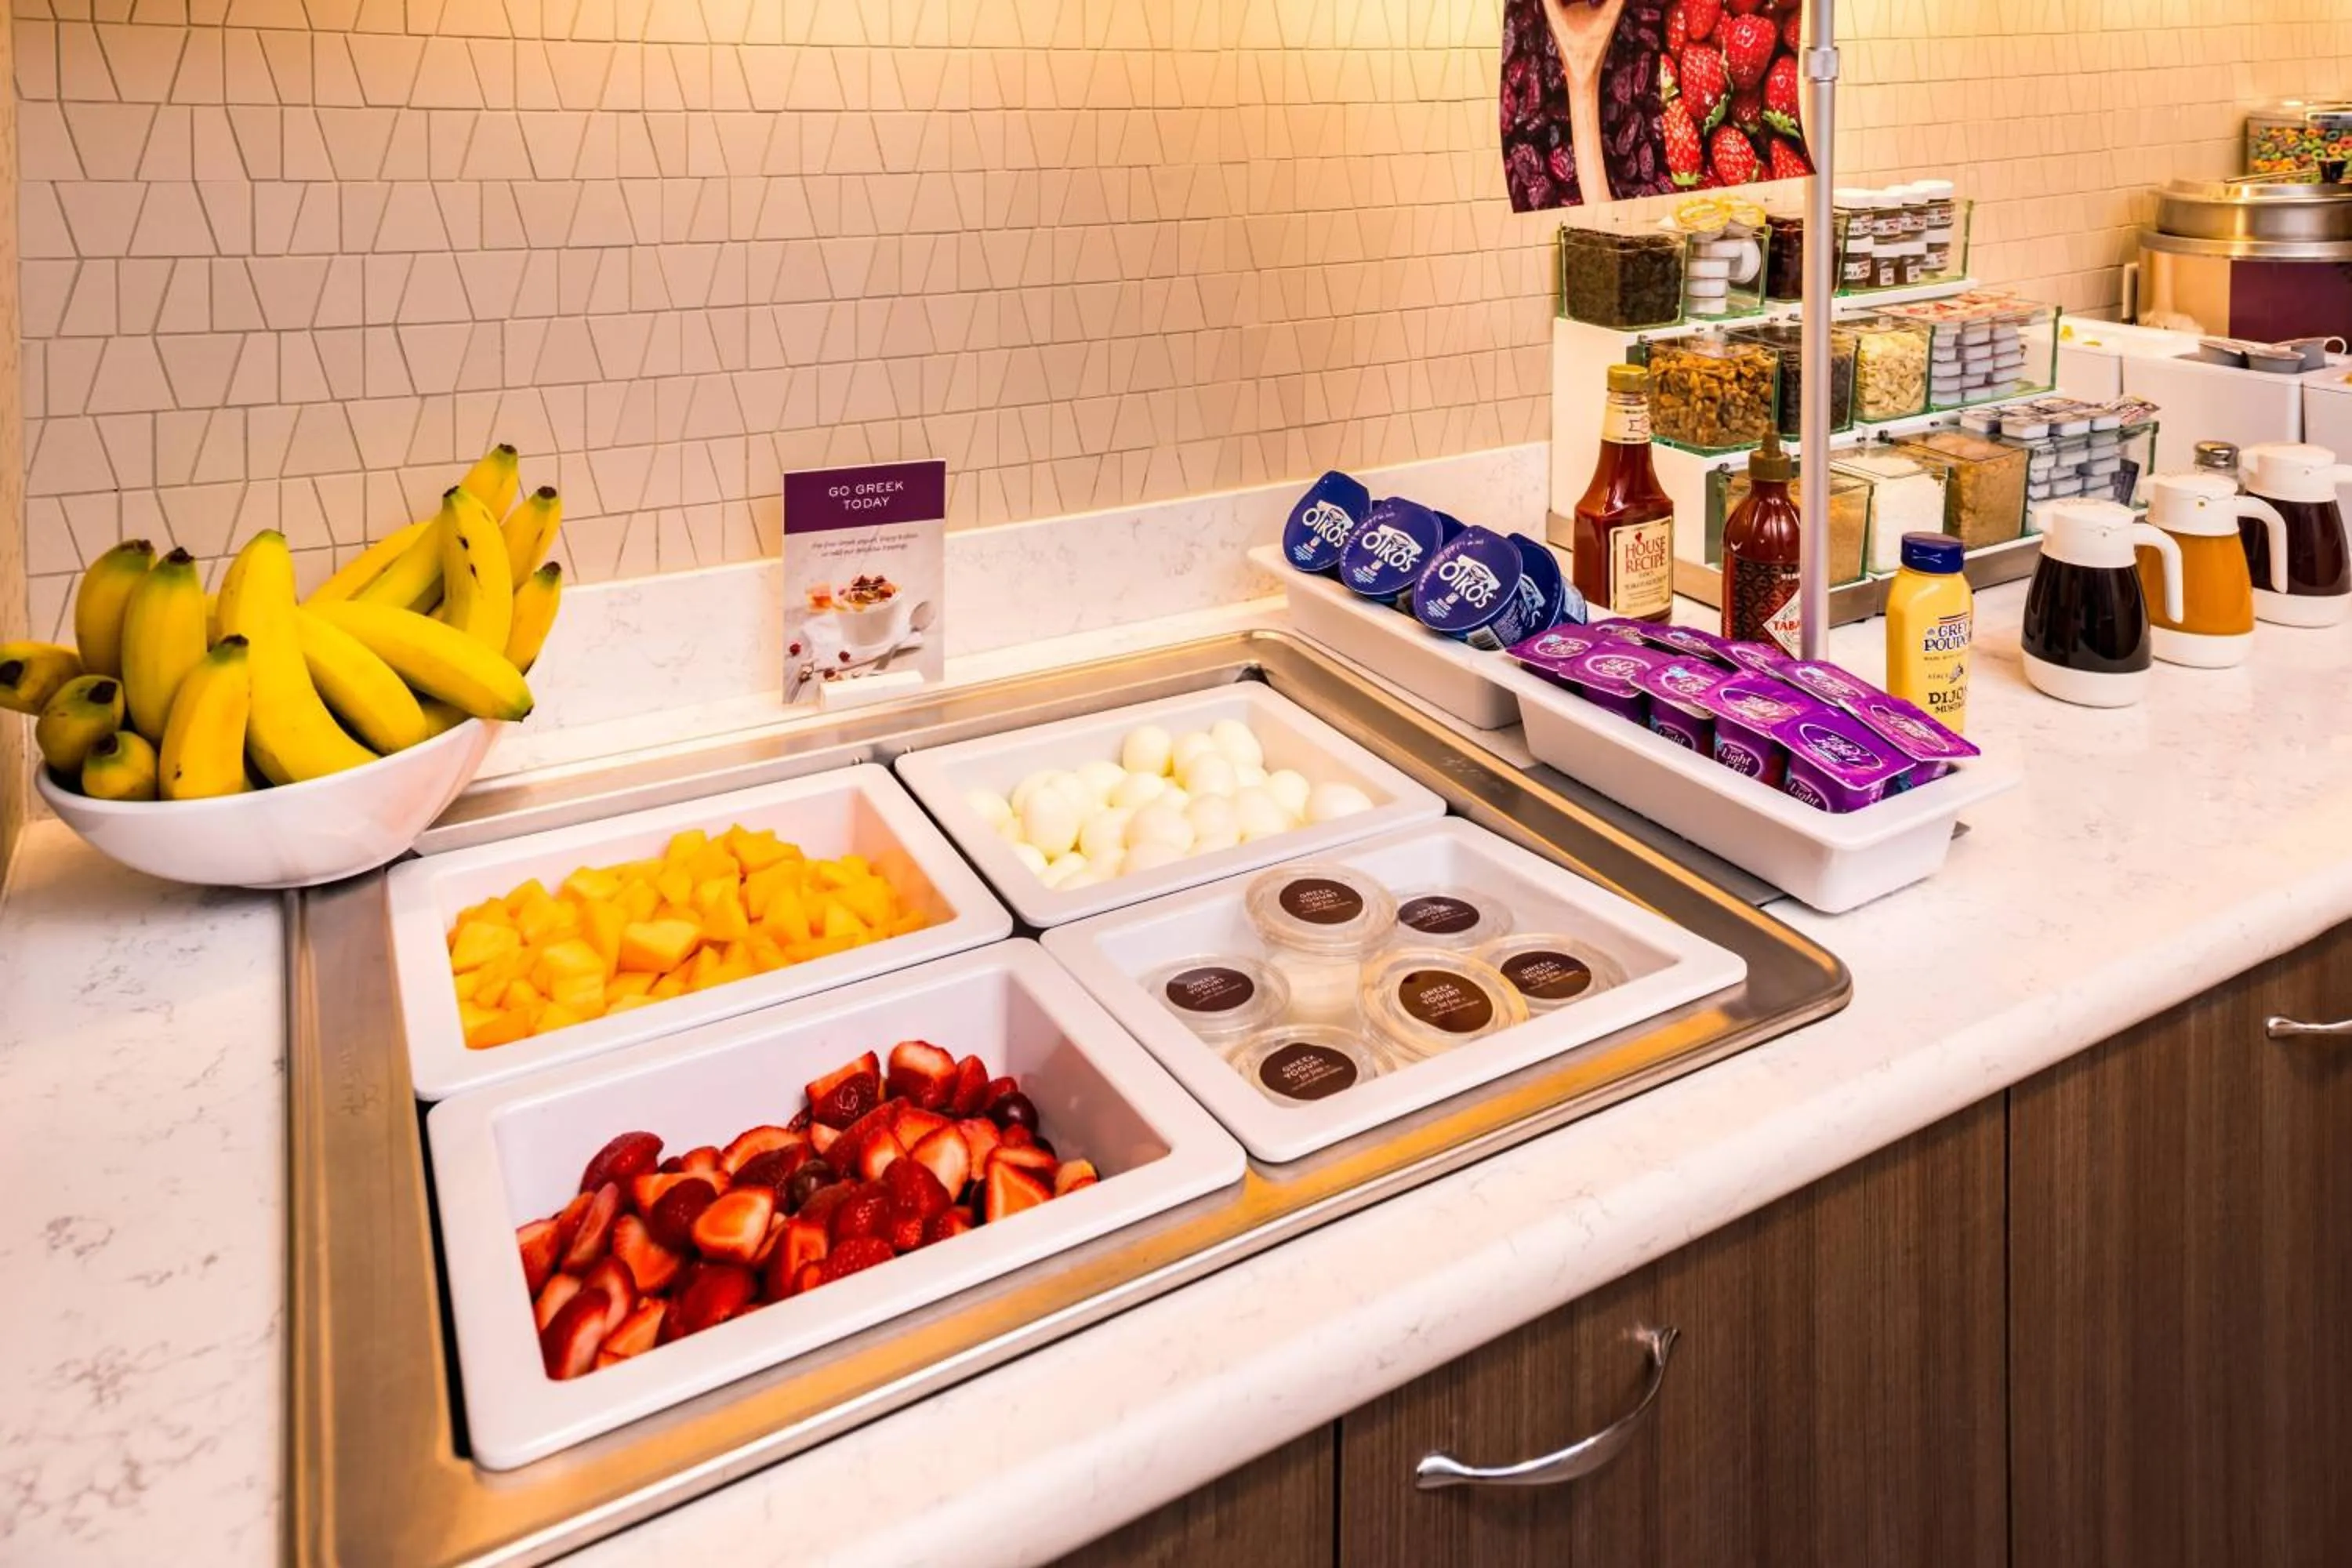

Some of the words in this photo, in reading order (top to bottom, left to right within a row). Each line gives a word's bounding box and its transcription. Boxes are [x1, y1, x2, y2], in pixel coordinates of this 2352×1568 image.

[829, 485, 851, 497] GO
[855, 481, 904, 495] GREEK
[843, 495, 891, 510] TODAY
[1362, 531, 1417, 573] OIKOS
[1625, 535, 1666, 559] HOUSE
[1625, 548, 1666, 574] RECIPE
[1439, 561, 1494, 608] OIKOS
[1722, 747, 1752, 766] Light
